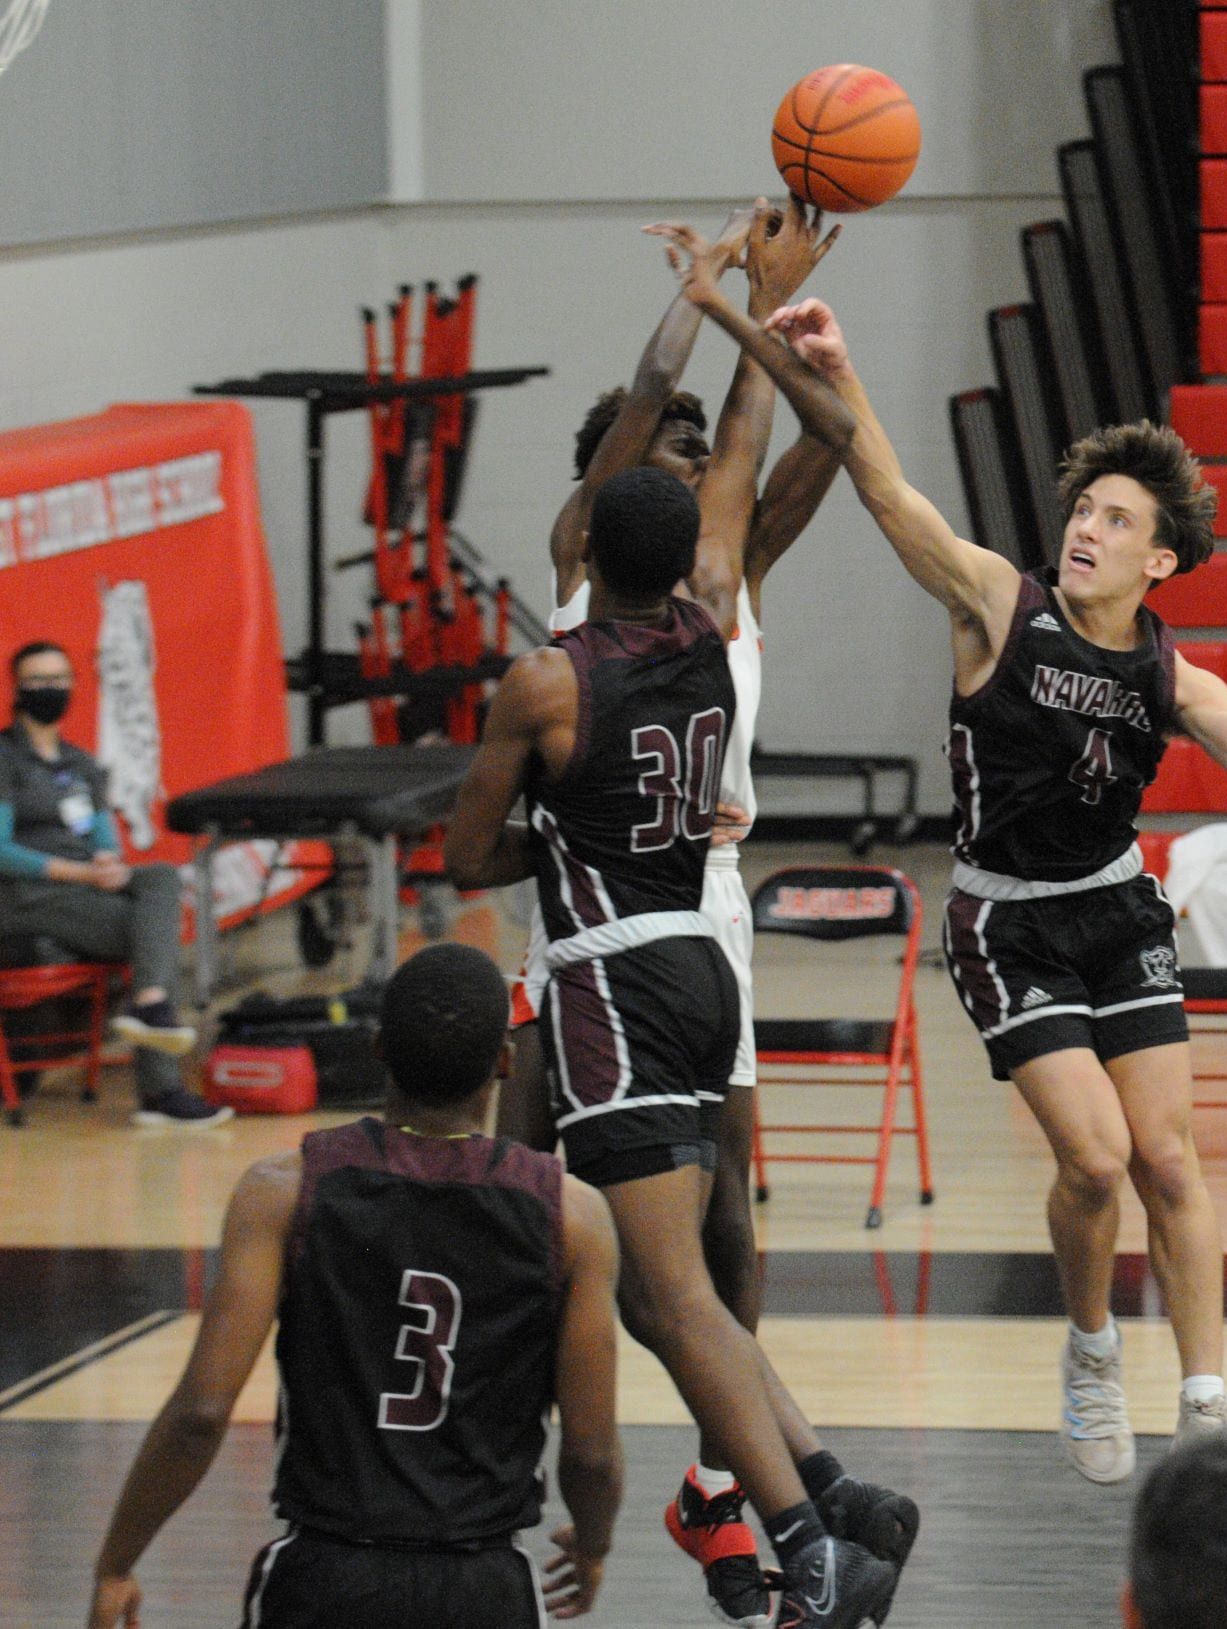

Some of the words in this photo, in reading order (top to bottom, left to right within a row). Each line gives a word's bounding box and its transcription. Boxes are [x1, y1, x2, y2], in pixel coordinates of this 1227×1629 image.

[630, 706, 726, 853] 30
[1067, 727, 1119, 805] 4
[377, 1268, 463, 1432] 3
